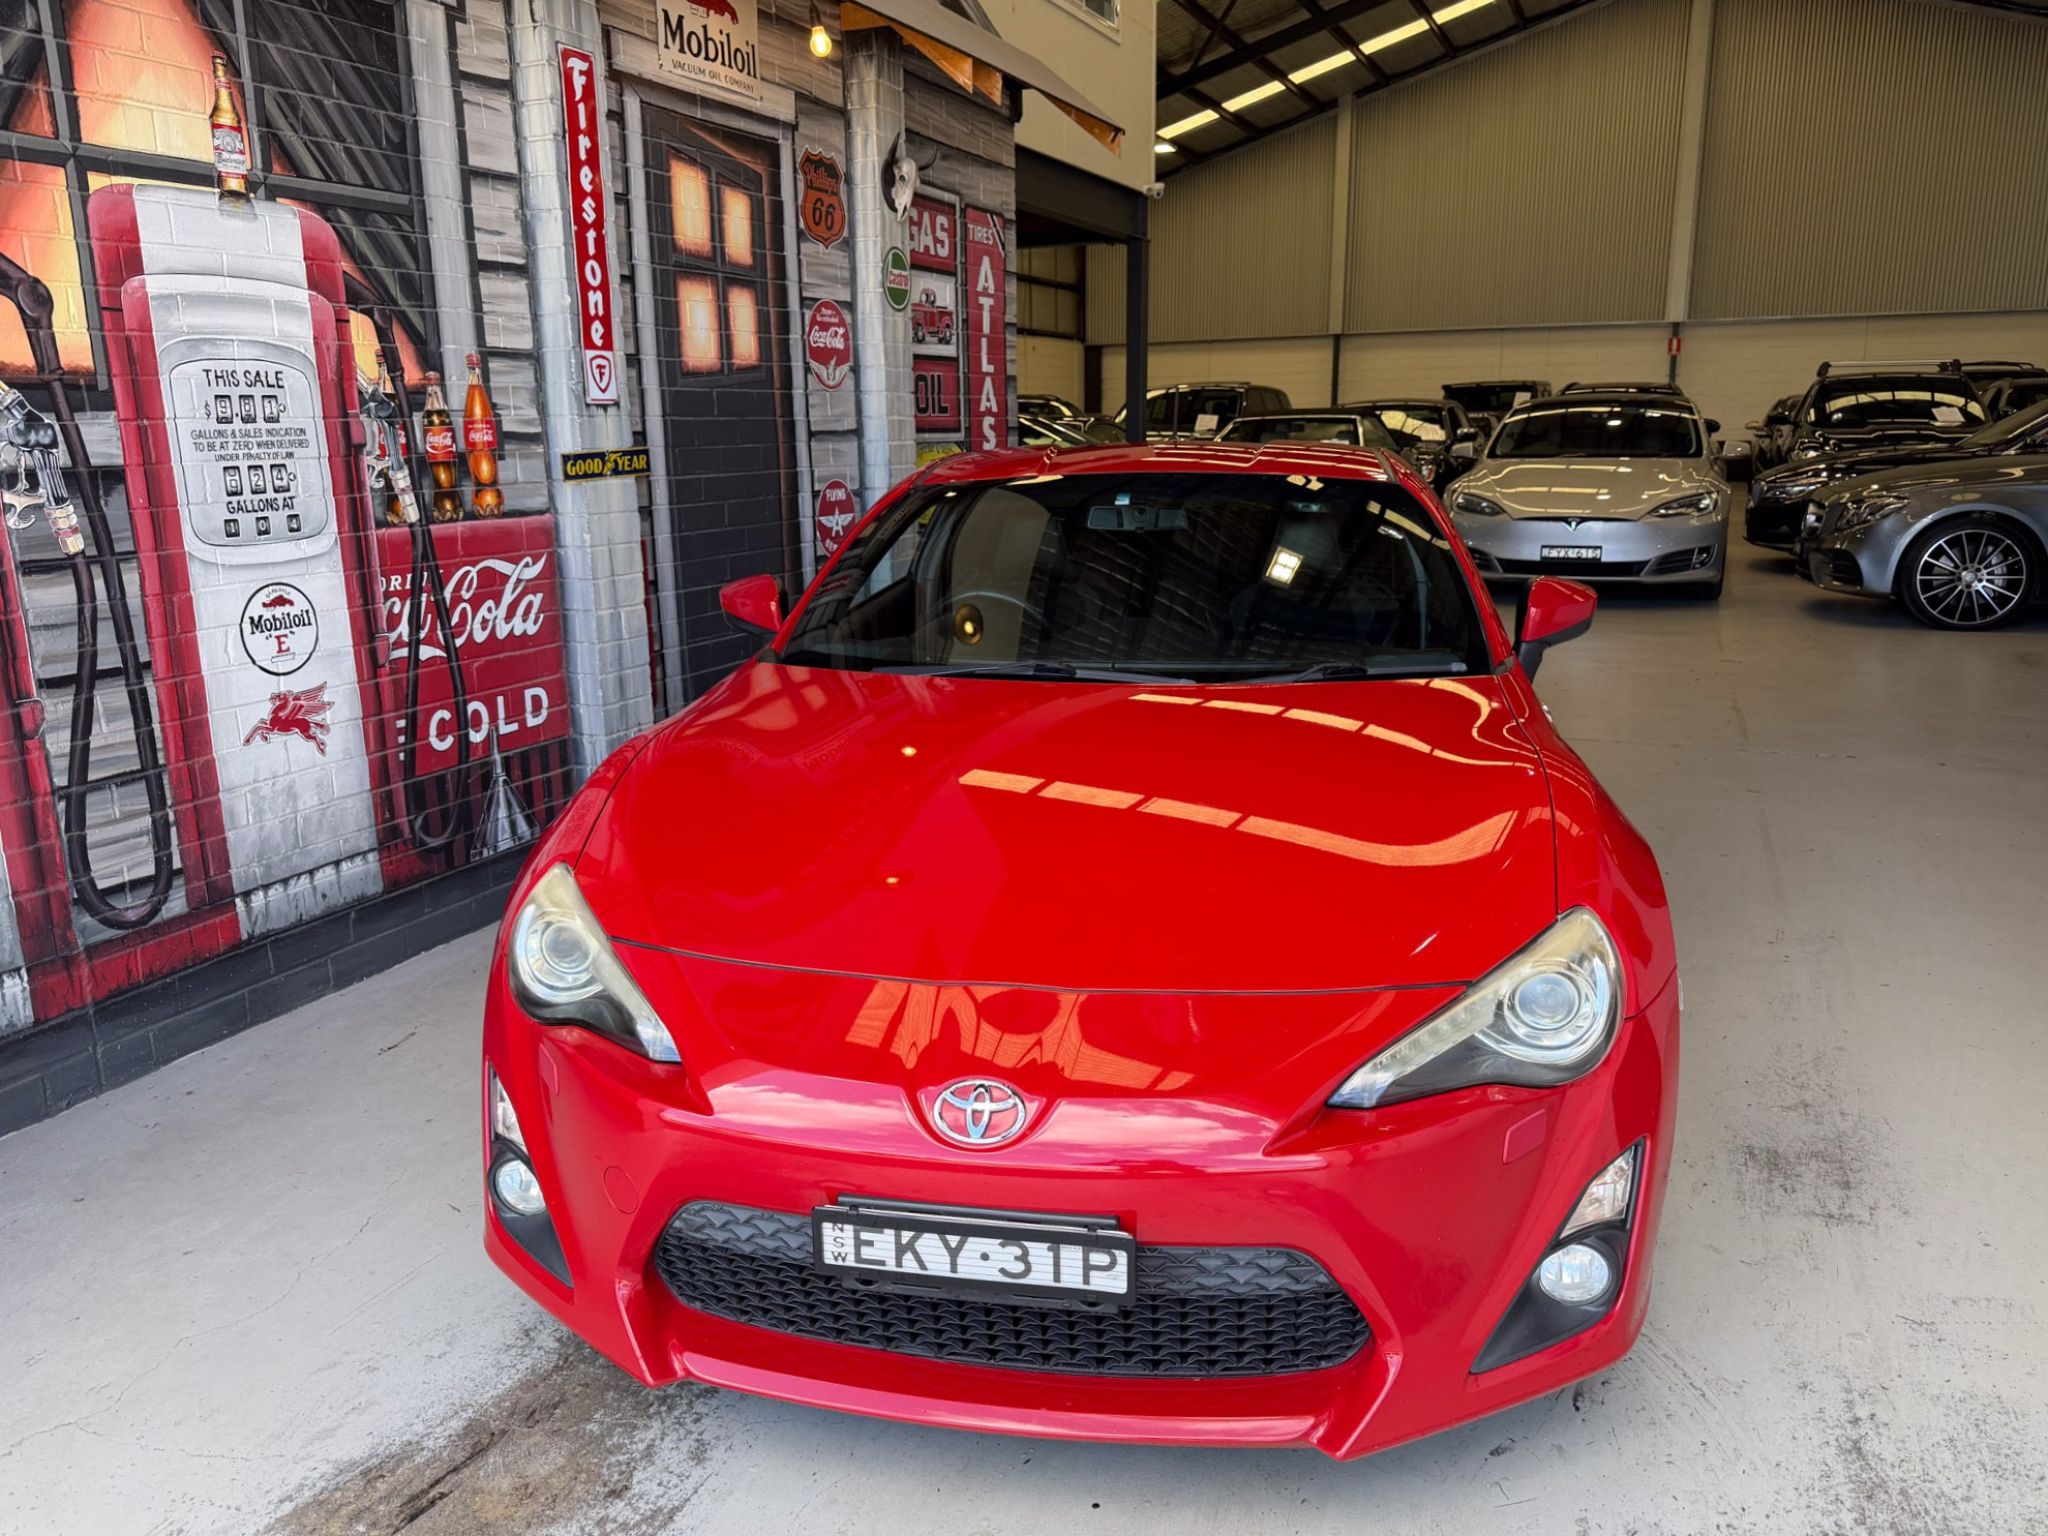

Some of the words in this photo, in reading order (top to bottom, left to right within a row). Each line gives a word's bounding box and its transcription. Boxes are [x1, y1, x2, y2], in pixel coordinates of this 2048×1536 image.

[662, 8, 758, 79] Mobiloil
[671, 59, 706, 77] VACUUM
[708, 70, 722, 82] OIL
[725, 75, 754, 93] COMPANY
[567, 57, 604, 347] Firestone
[812, 198, 836, 231] 66
[908, 207, 949, 258] GAS
[967, 224, 993, 245] TIRES
[976, 255, 998, 450] ATLAS
[202, 369, 240, 388] THIS
[244, 370, 285, 389] SALE
[915, 372, 950, 416] OIL
[191, 429, 229, 441] GALLONS
[240, 428, 263, 439] SALES
[265, 427, 306, 438] INDICATION
[192, 441, 205, 452] TO
[207, 441, 218, 452] BE
[219, 441, 230, 451] AT
[232, 440, 254, 451] ZERO
[256, 440, 275, 450] WHEN
[277, 439, 309, 449] DELIVERED
[215, 453, 240, 462] UNDER
[242, 452, 271, 461] PENALTY
[272, 452, 280, 460] OF
[280, 451, 295, 460] LAW
[566, 458, 603, 476] GOOD
[617, 455, 647, 471] YEAR
[226, 497, 280, 514] GALLONS
[281, 496, 296, 511] AT
[248, 609, 312, 635] Mobiloil
[428, 686, 549, 751] COLD
[831, 1222, 848, 1264] NSW
